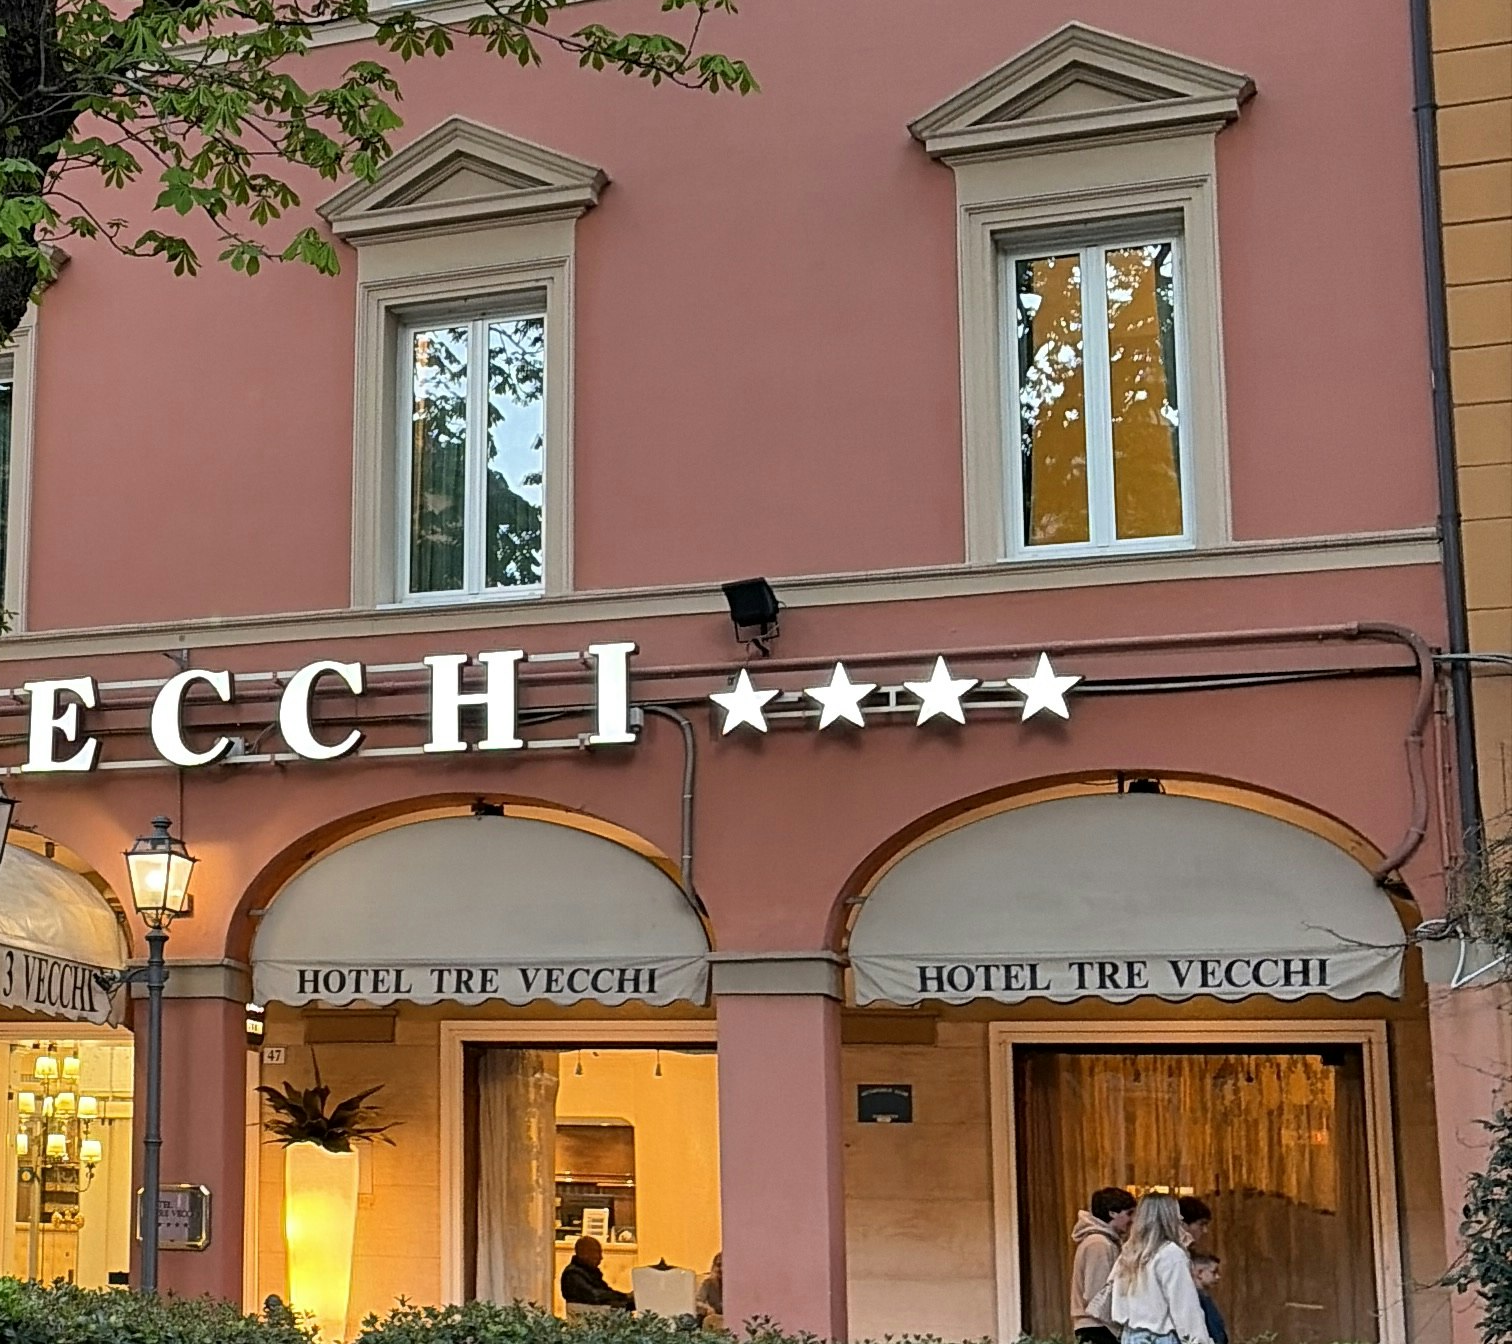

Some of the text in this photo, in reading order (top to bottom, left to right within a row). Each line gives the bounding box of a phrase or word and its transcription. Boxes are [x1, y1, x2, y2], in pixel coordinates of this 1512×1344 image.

[20, 641, 640, 773] ECCHI
[3, 950, 15, 997] 3
[23, 954, 99, 1012] VECCHI
[297, 967, 659, 995] HOTEL TRE VECCHI
[916, 958, 1331, 993] HOTEL TRE VECCHI
[267, 1049, 282, 1062] 47
